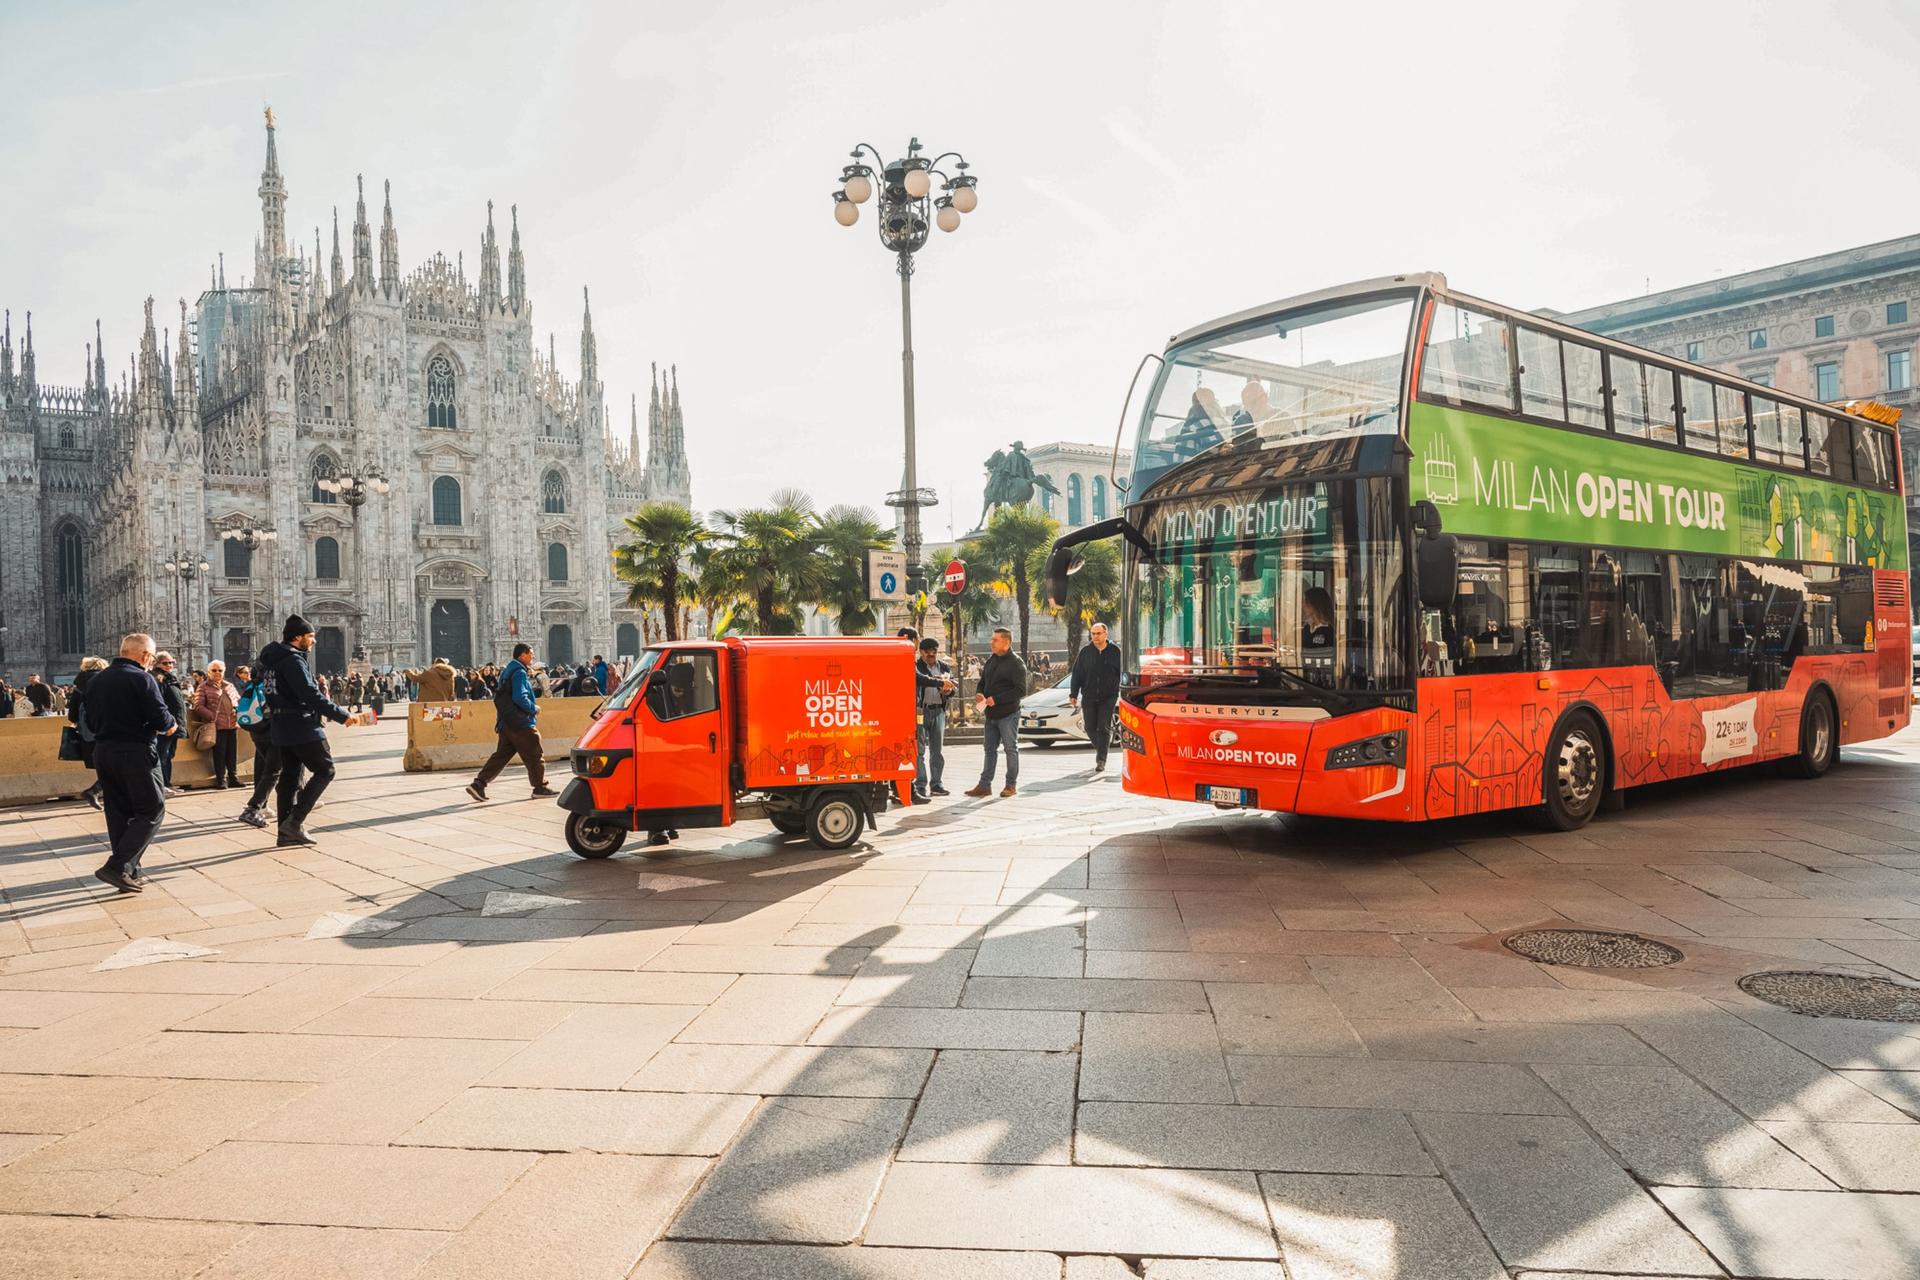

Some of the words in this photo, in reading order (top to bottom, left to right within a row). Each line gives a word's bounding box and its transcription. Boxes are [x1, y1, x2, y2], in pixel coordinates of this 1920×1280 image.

[1472, 456, 1570, 516] MILAN
[1575, 472, 1654, 525] OPEN
[1658, 484, 1727, 532] TOUR
[1165, 508, 1216, 542] MILAN
[805, 680, 863, 695] MILAN
[805, 695, 863, 712] OPEN
[806, 711, 862, 728] TOUR
[1178, 746, 1213, 761] MILAN
[1215, 749, 1253, 763] OPEN
[1255, 751, 1297, 767] TOUR
